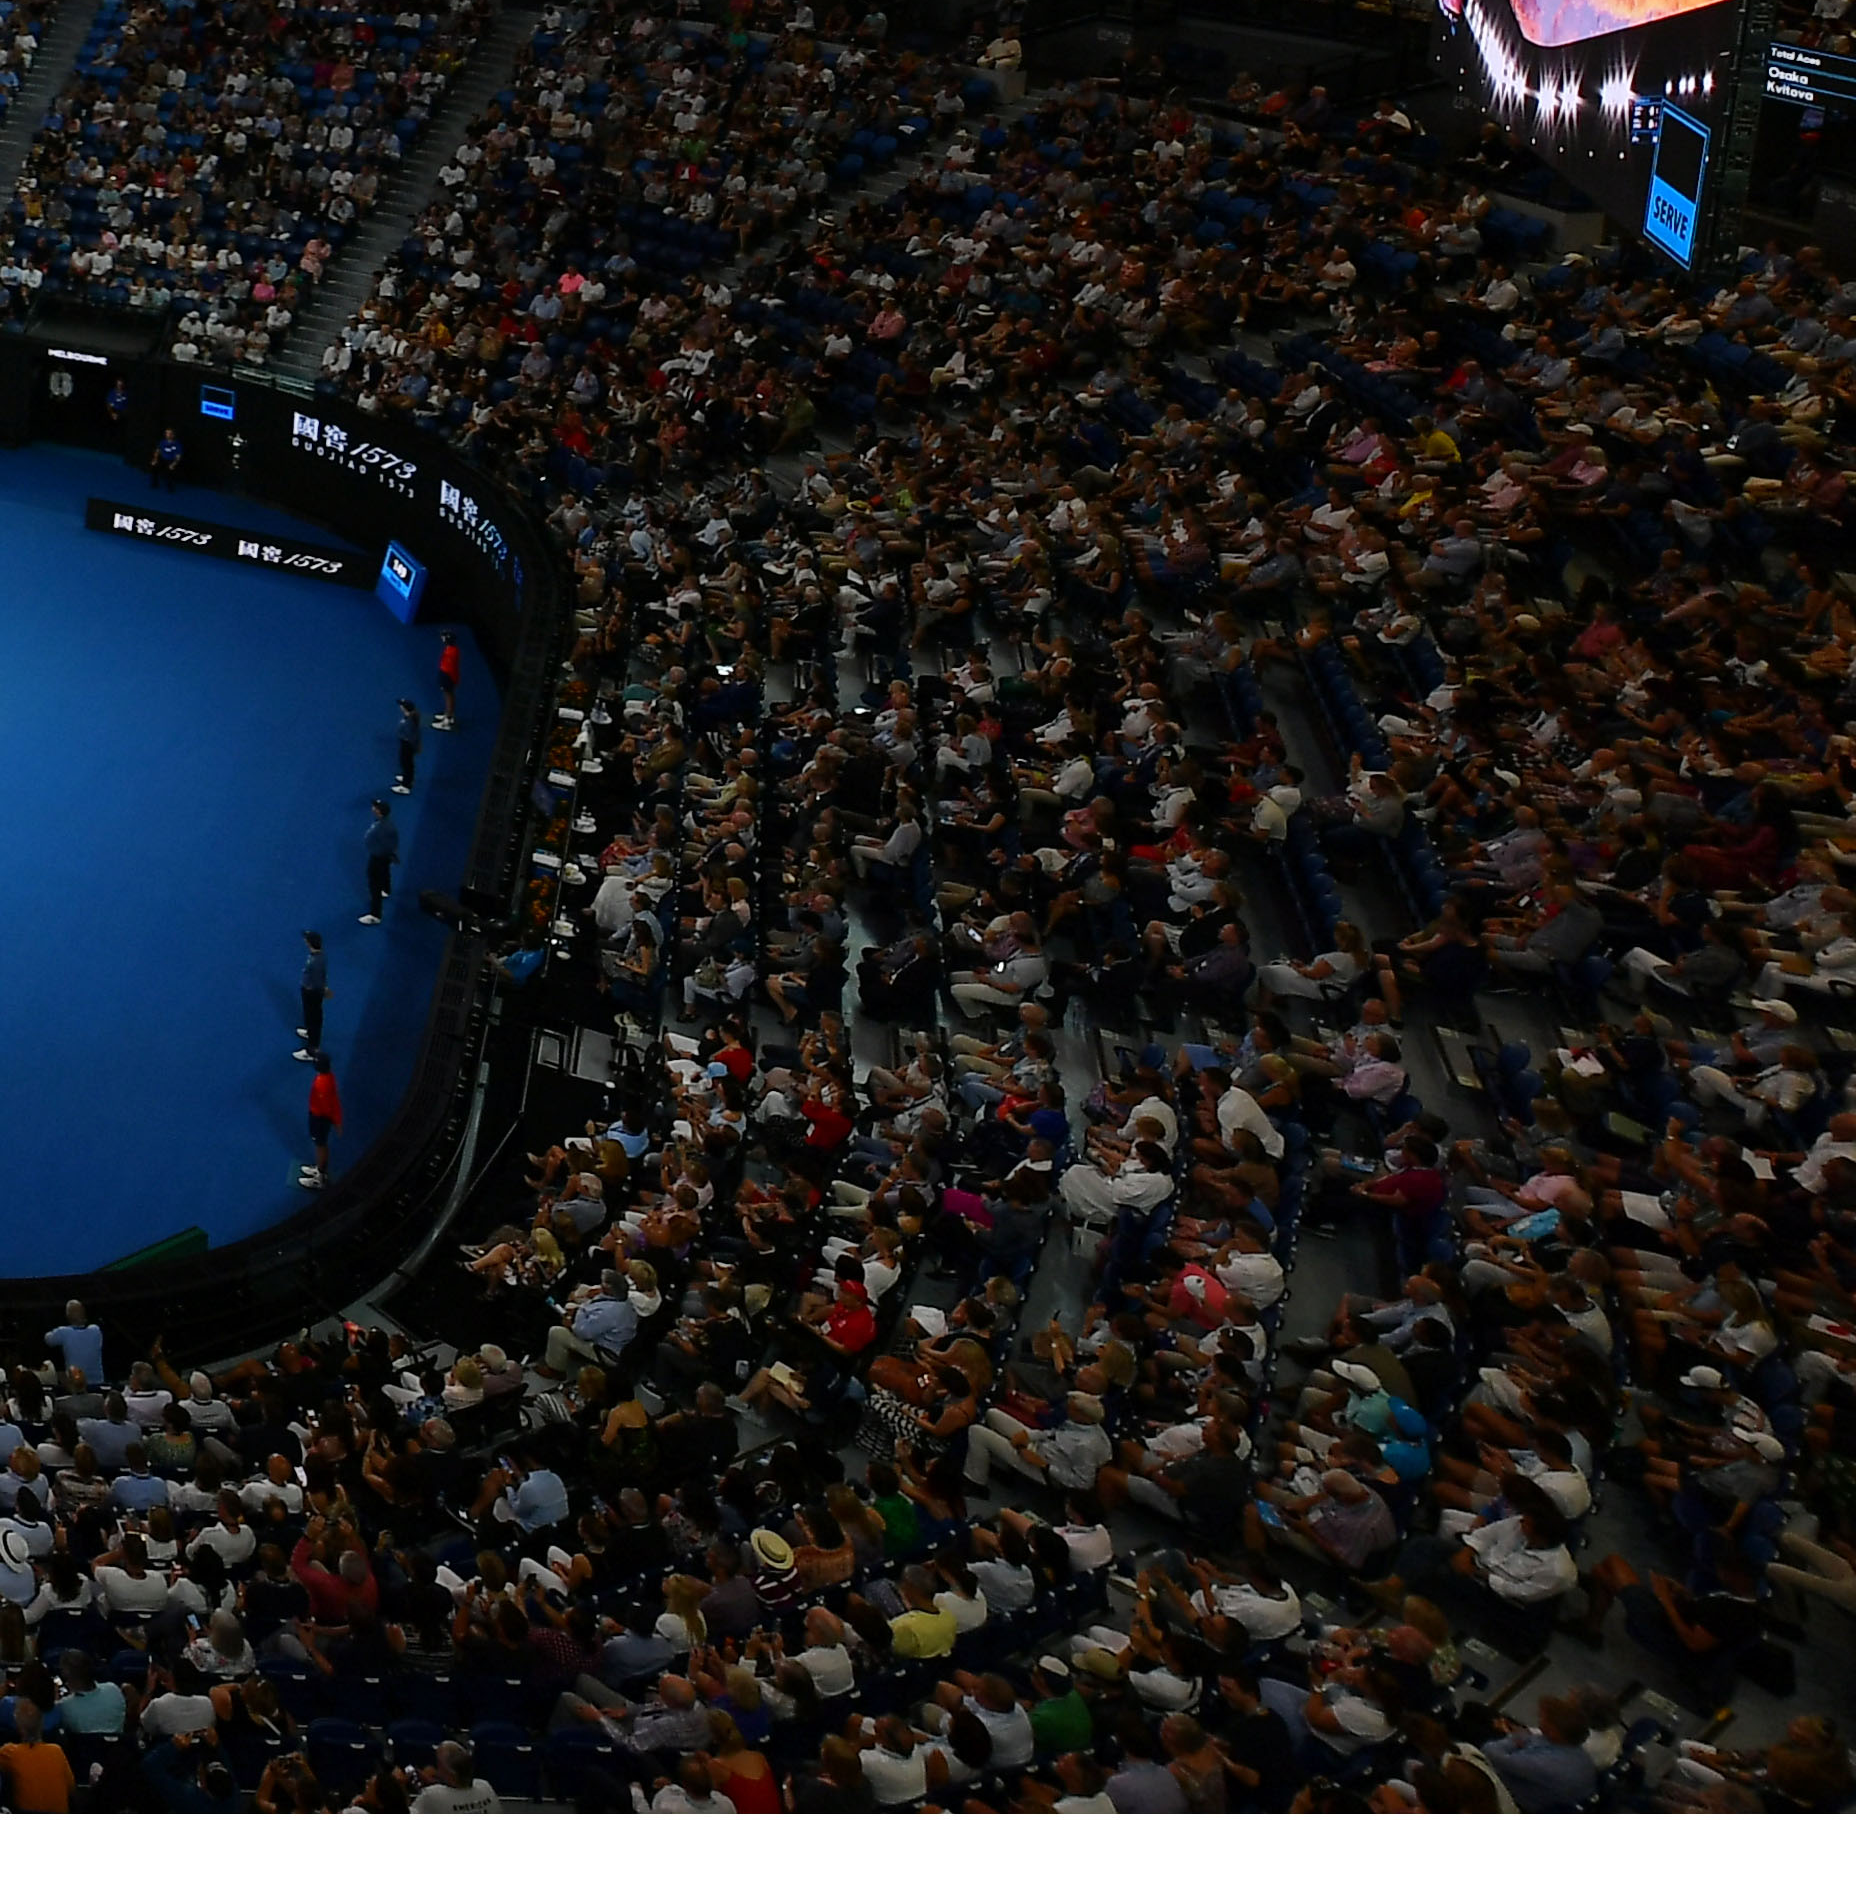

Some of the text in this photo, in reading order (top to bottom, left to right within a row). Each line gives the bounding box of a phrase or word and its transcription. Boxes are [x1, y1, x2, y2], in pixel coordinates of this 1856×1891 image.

[1772, 46, 1822, 66] Total Aces
[1769, 66, 1808, 85] Osaka
[1767, 81, 1814, 102] Kvitova
[1653, 195, 1689, 240] SERVE
[292, 437, 415, 499] GUOJIAO 1573
